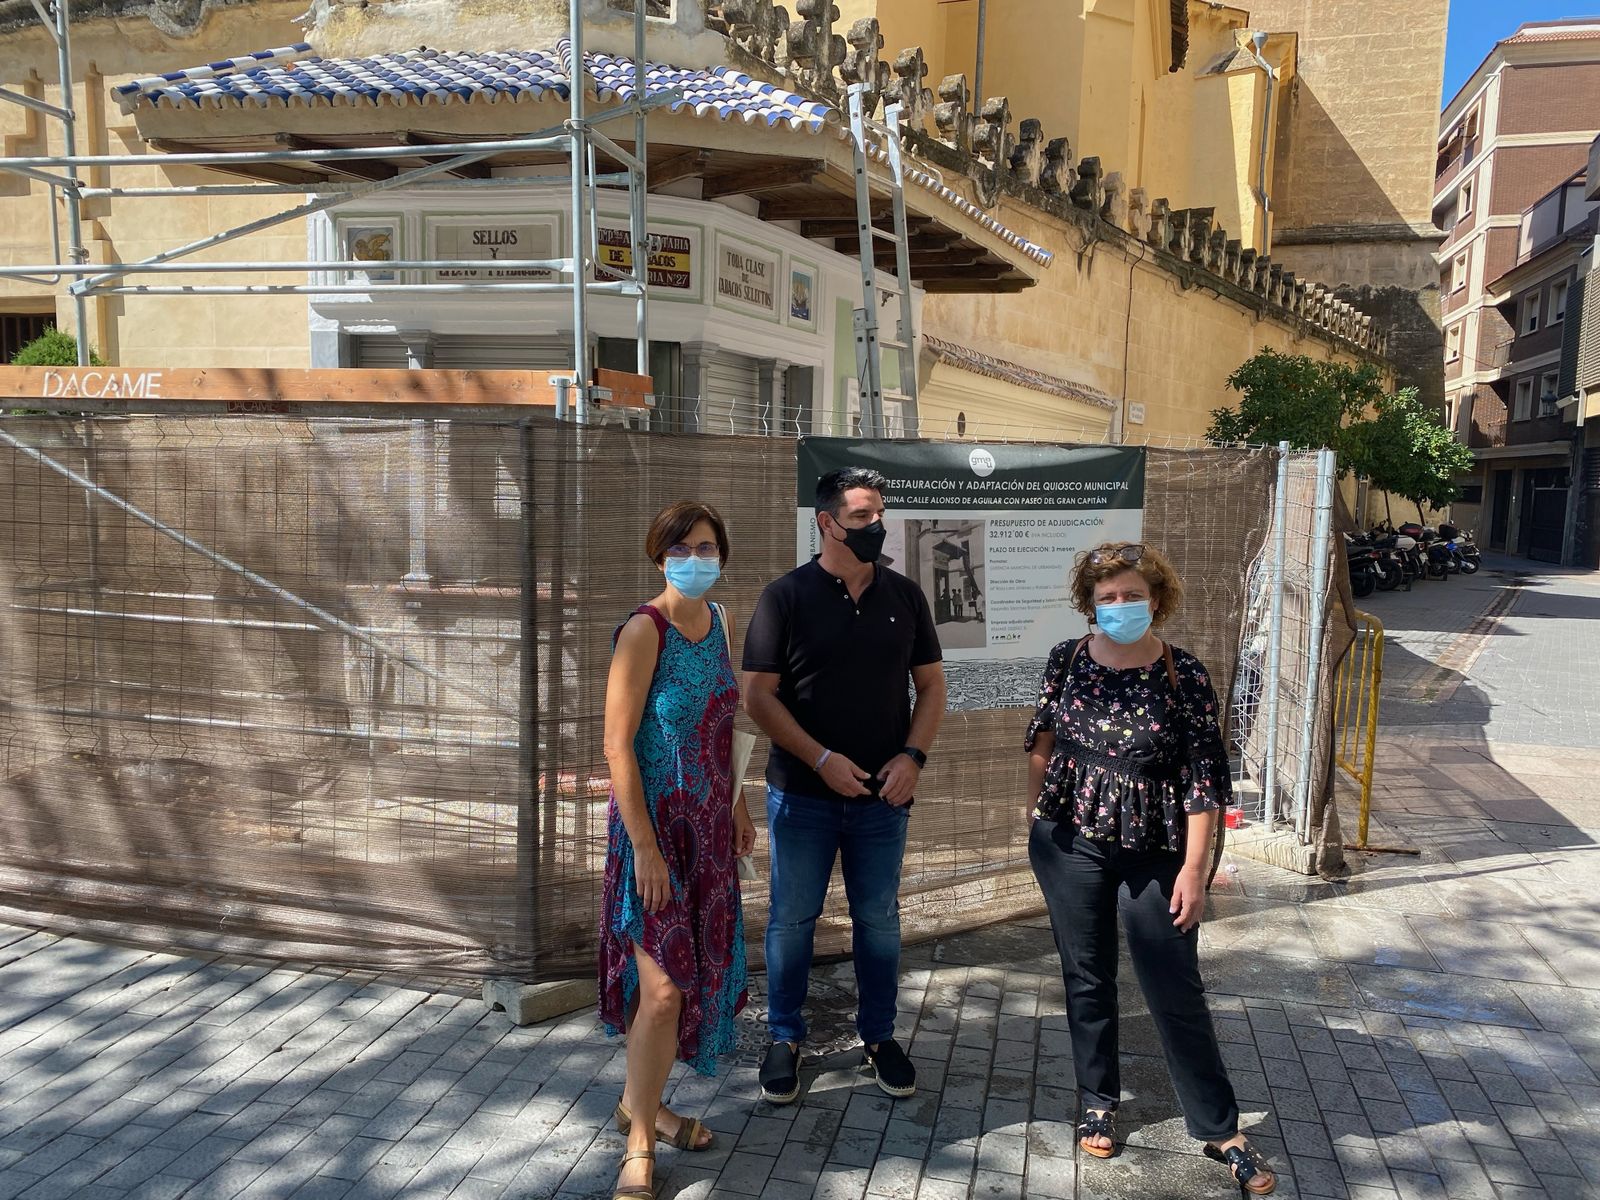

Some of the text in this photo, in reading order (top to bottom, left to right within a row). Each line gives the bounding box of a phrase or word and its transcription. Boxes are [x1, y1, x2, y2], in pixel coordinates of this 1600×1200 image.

[472, 229, 518, 245] SELLOS
[489, 247, 499, 259] Y
[609, 249, 624, 262] DE
[727, 251, 765, 278] TODA CLASE
[718, 276, 772, 307] TABACOS SELECTOS
[42, 371, 162, 398] DACAME
[885, 478, 1129, 491] RESTAURACIÓN Y ADAPTACIÓN DEL QUIOSCO MUNICIPAL
[882, 495, 1107, 505] QUINA CALLE ALONSO DE AGUILAR CON PASEO DEL GRAN CAPITÁN
[990, 519, 1036, 528] PRESUPUESTO
[1037, 519, 1047, 527] DE
